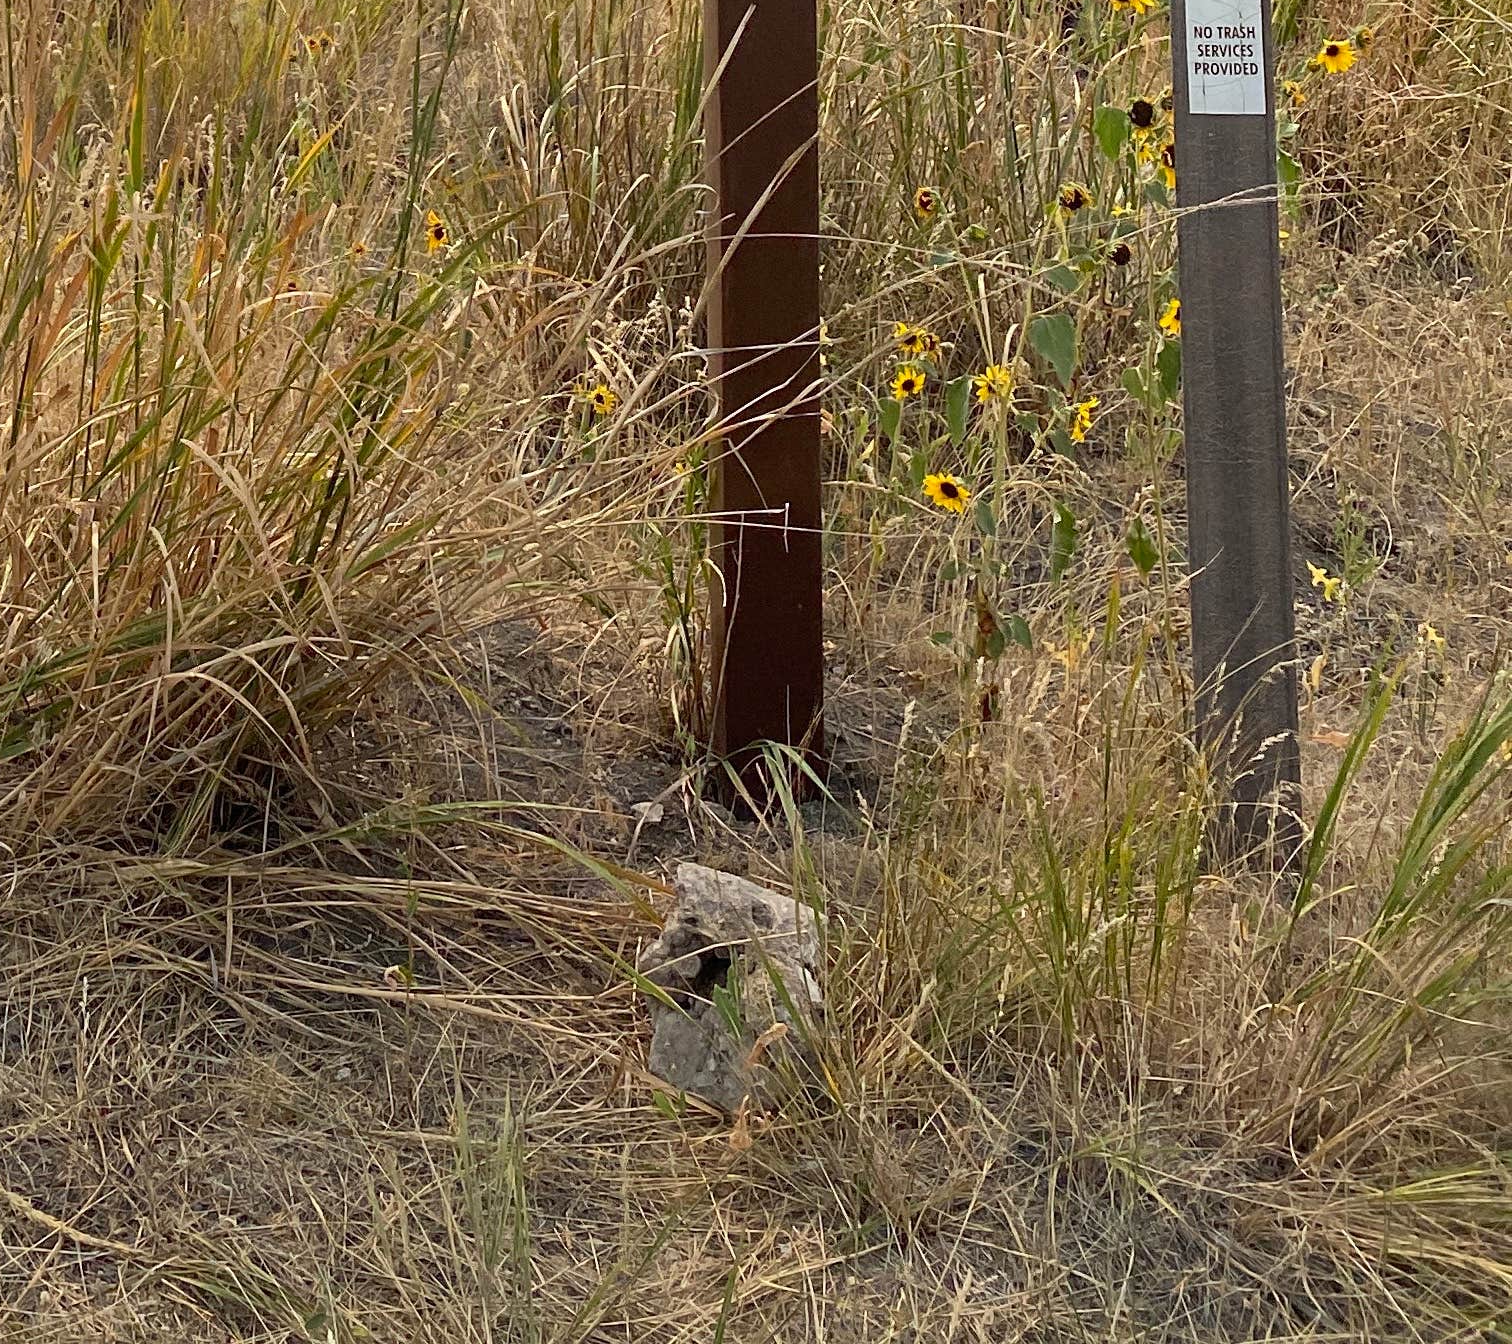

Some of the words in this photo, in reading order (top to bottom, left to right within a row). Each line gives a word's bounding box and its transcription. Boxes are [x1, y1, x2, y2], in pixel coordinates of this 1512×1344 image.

[1194, 26, 1212, 39] NO
[1217, 26, 1256, 39] TRASH
[1197, 44, 1253, 58] SERVICES
[1194, 62, 1258, 76] PROVIDED
